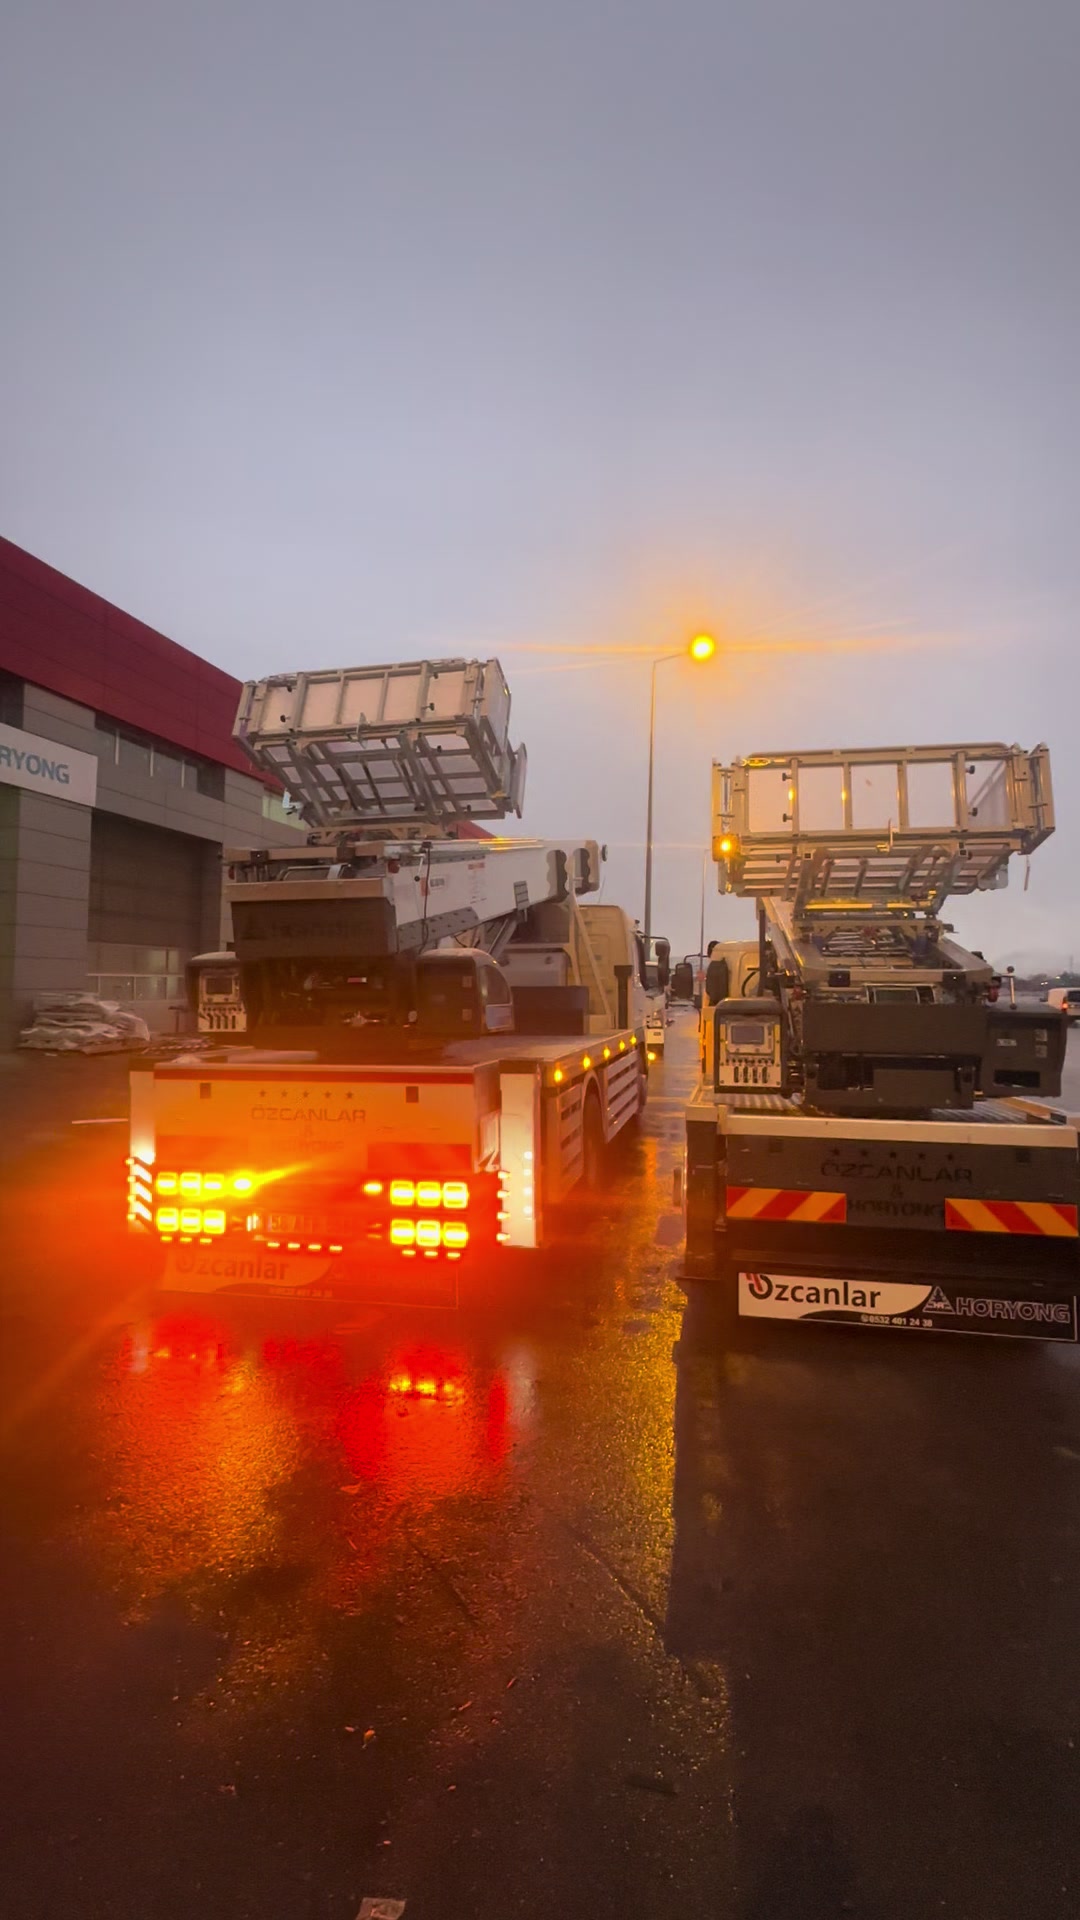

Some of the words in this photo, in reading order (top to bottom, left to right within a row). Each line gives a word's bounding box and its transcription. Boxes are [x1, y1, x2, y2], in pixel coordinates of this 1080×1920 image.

[0, 745, 70, 784] RYONG
[869, 1315, 890, 1325] 0532
[892, 1316, 907, 1326] 401
[909, 1317, 921, 1327] 24
[956, 1296, 1070, 1324] HORYONG
